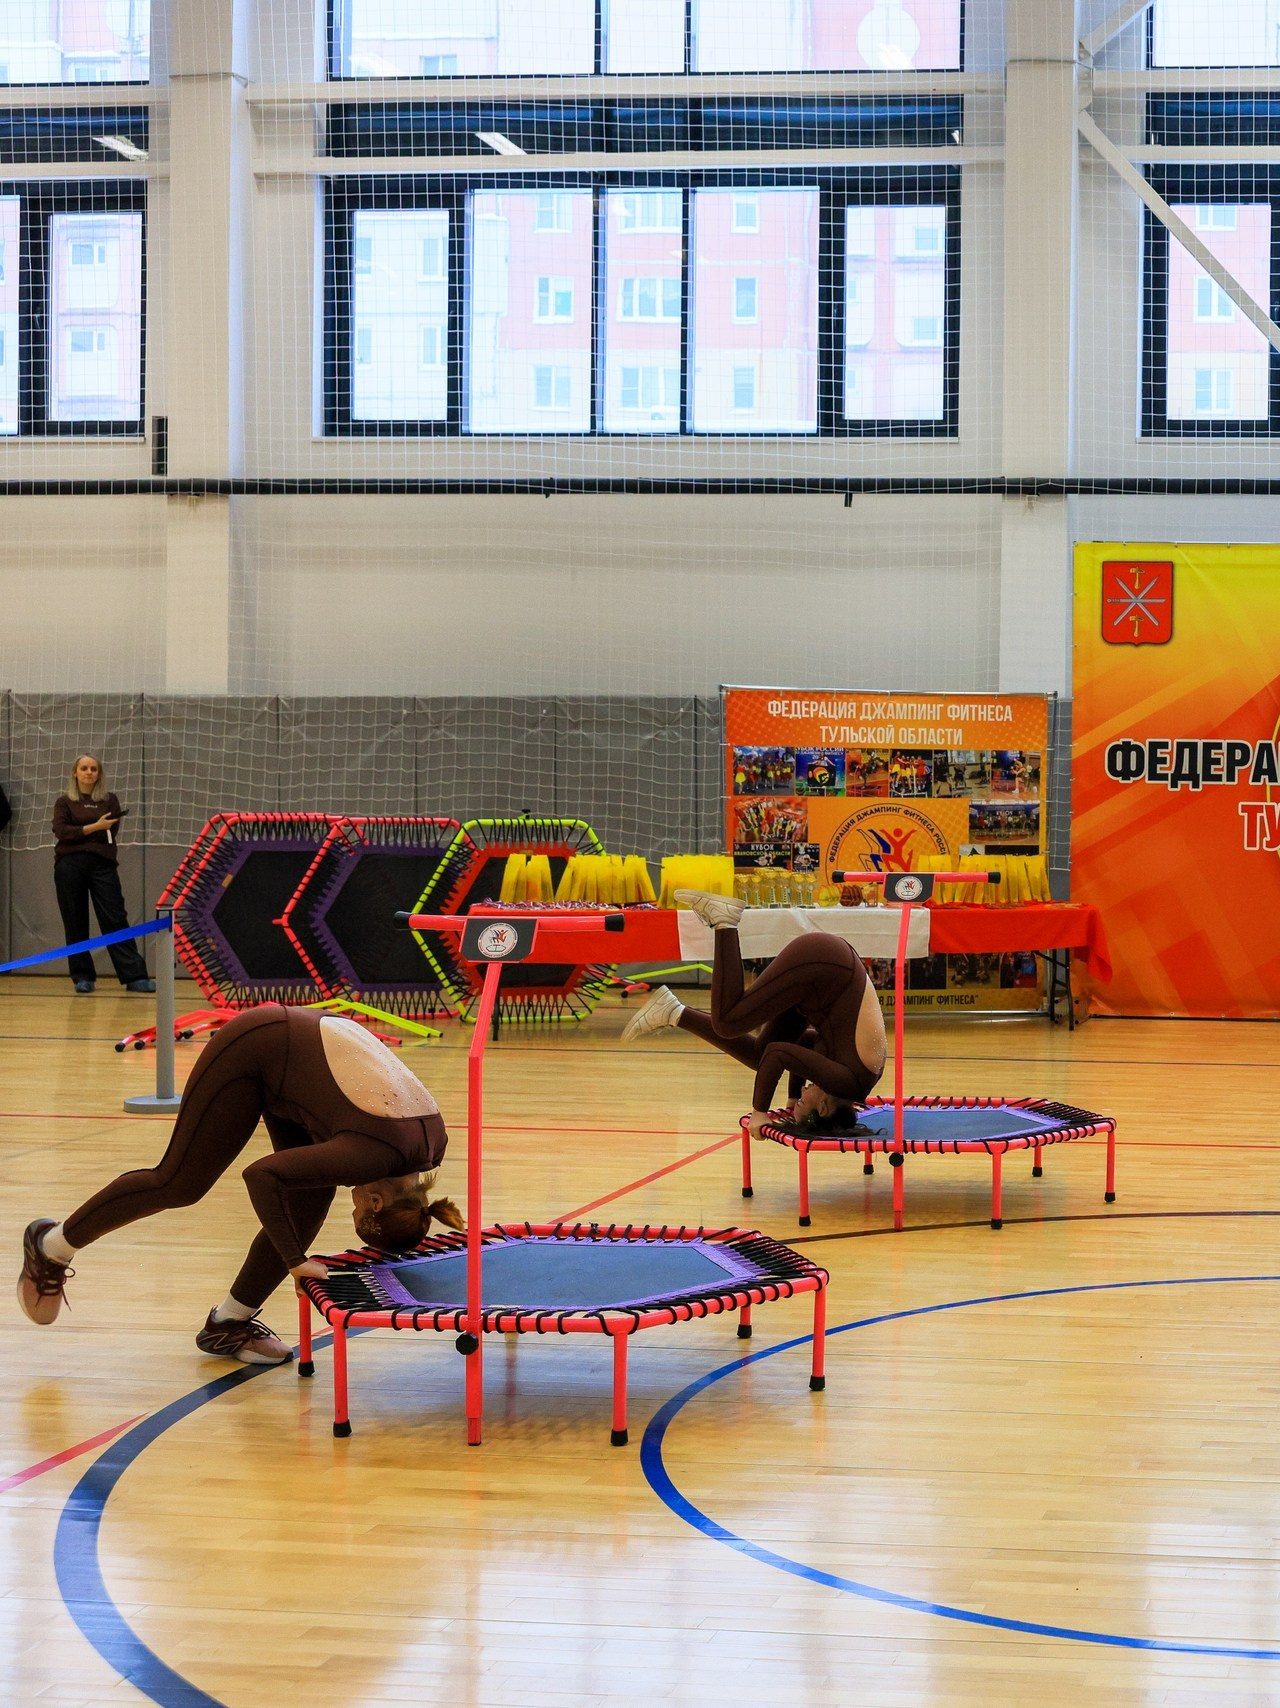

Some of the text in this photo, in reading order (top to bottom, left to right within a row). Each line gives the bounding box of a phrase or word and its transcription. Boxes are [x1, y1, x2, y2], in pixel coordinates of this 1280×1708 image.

[768, 699, 1013, 722] ФЕДЕРАЦИЯ ДЖАМПИНГ ФИТНЕСА
[820, 724, 963, 745] ТУЛЬСКОЙ ОБЛАСТИ
[829, 806, 946, 863] ФЕДЕРАЦИЯ ДЖАМПИНГ ФИТНЕСА РОСС
[886, 995, 935, 1006] ДМПИНГ
